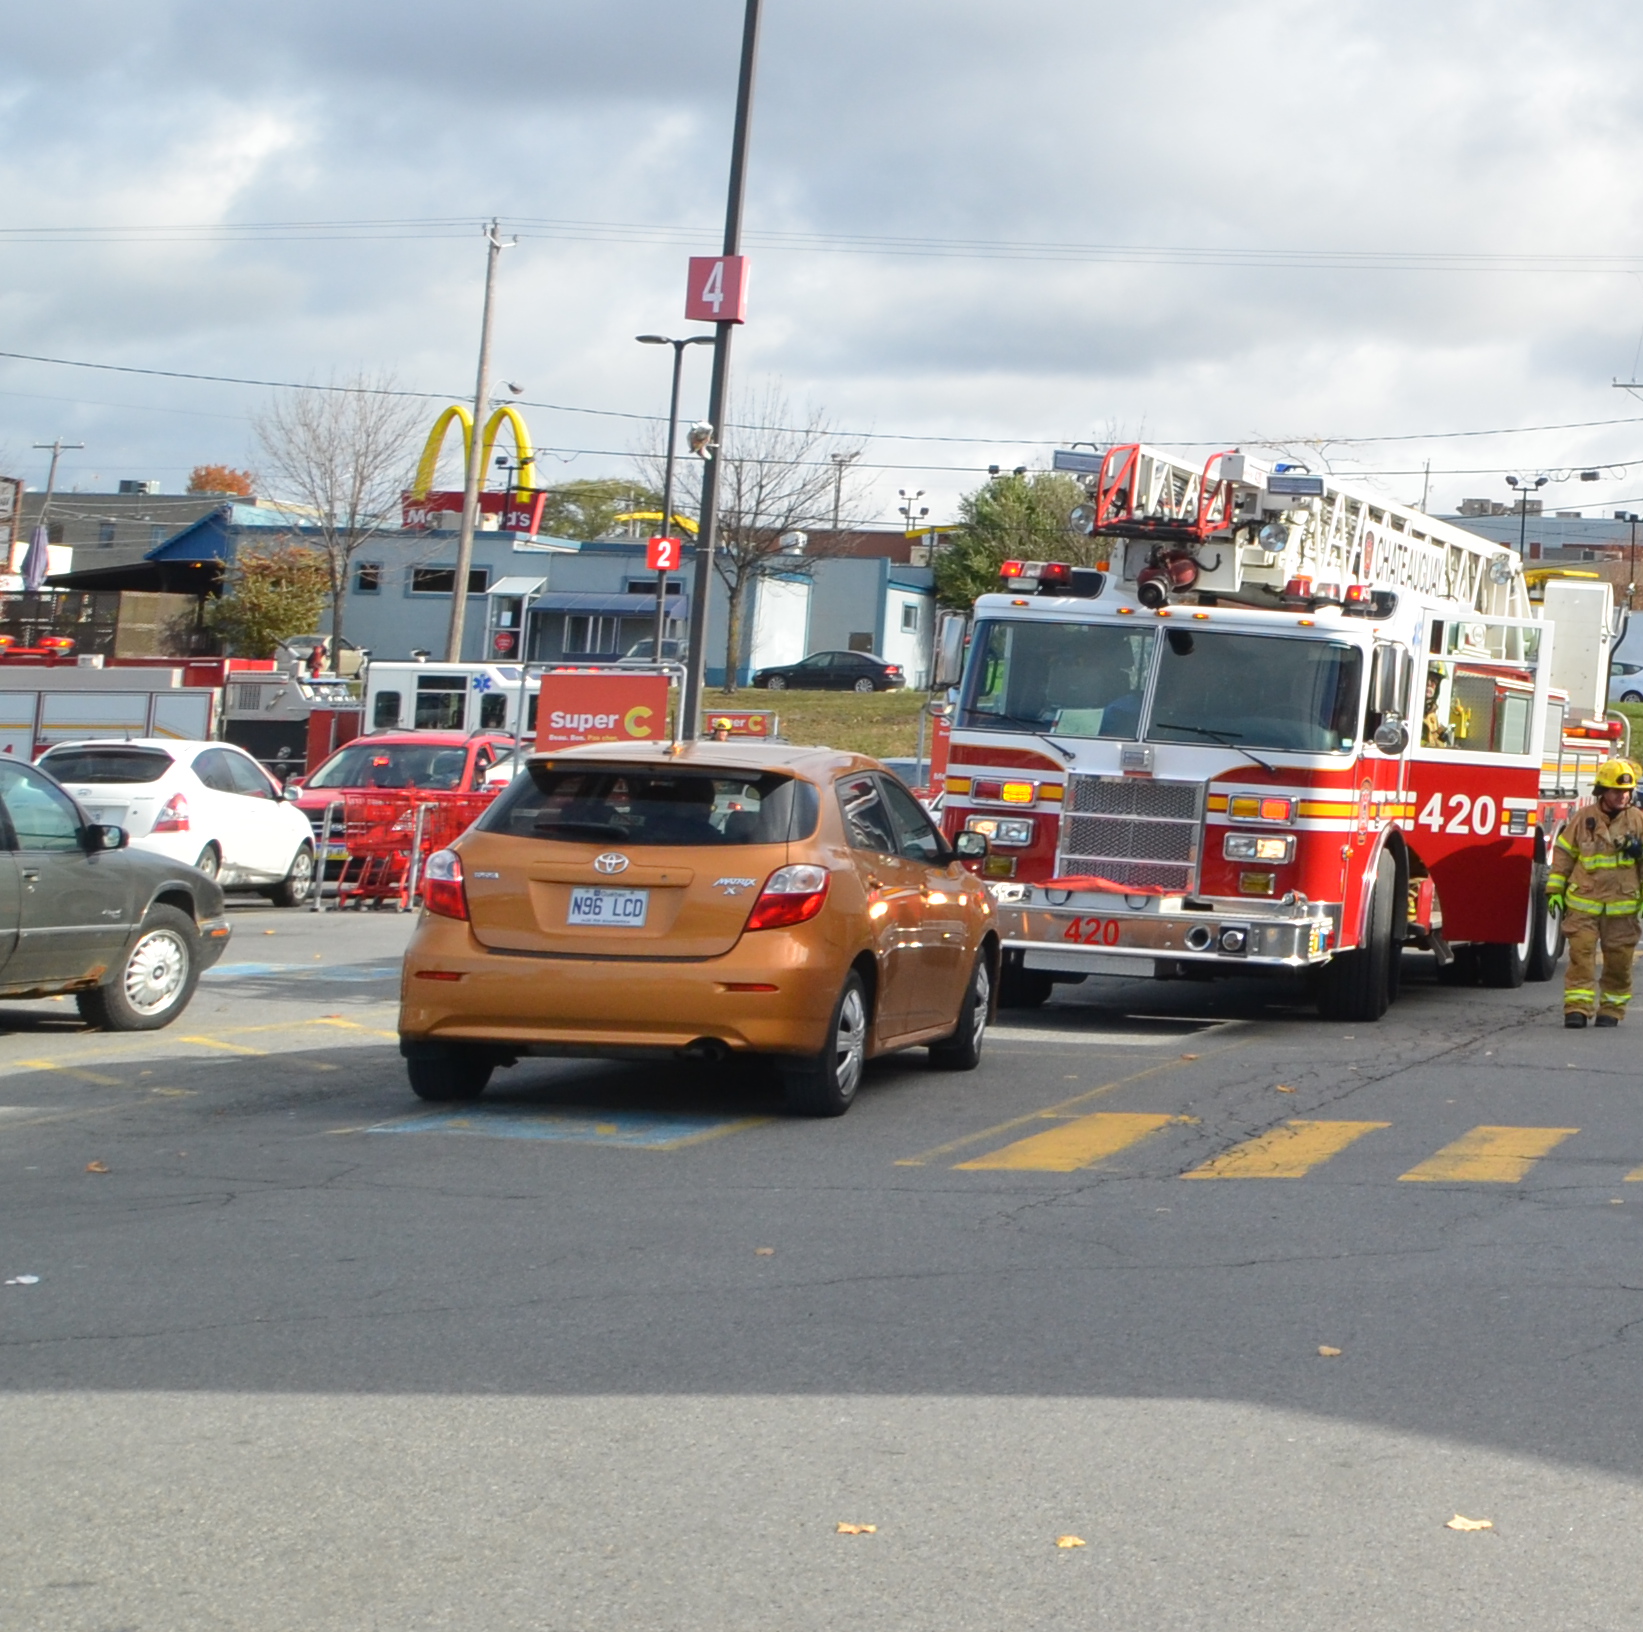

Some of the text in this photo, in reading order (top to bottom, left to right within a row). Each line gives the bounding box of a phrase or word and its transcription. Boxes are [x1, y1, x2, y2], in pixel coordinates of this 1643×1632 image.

[702, 262, 724, 313] 4
[656, 541, 671, 567] 2
[550, 705, 653, 738] Super C
[1418, 792, 1496, 836] 420
[572, 896, 643, 918] N96 LCD
[1064, 916, 1119, 946] 420
